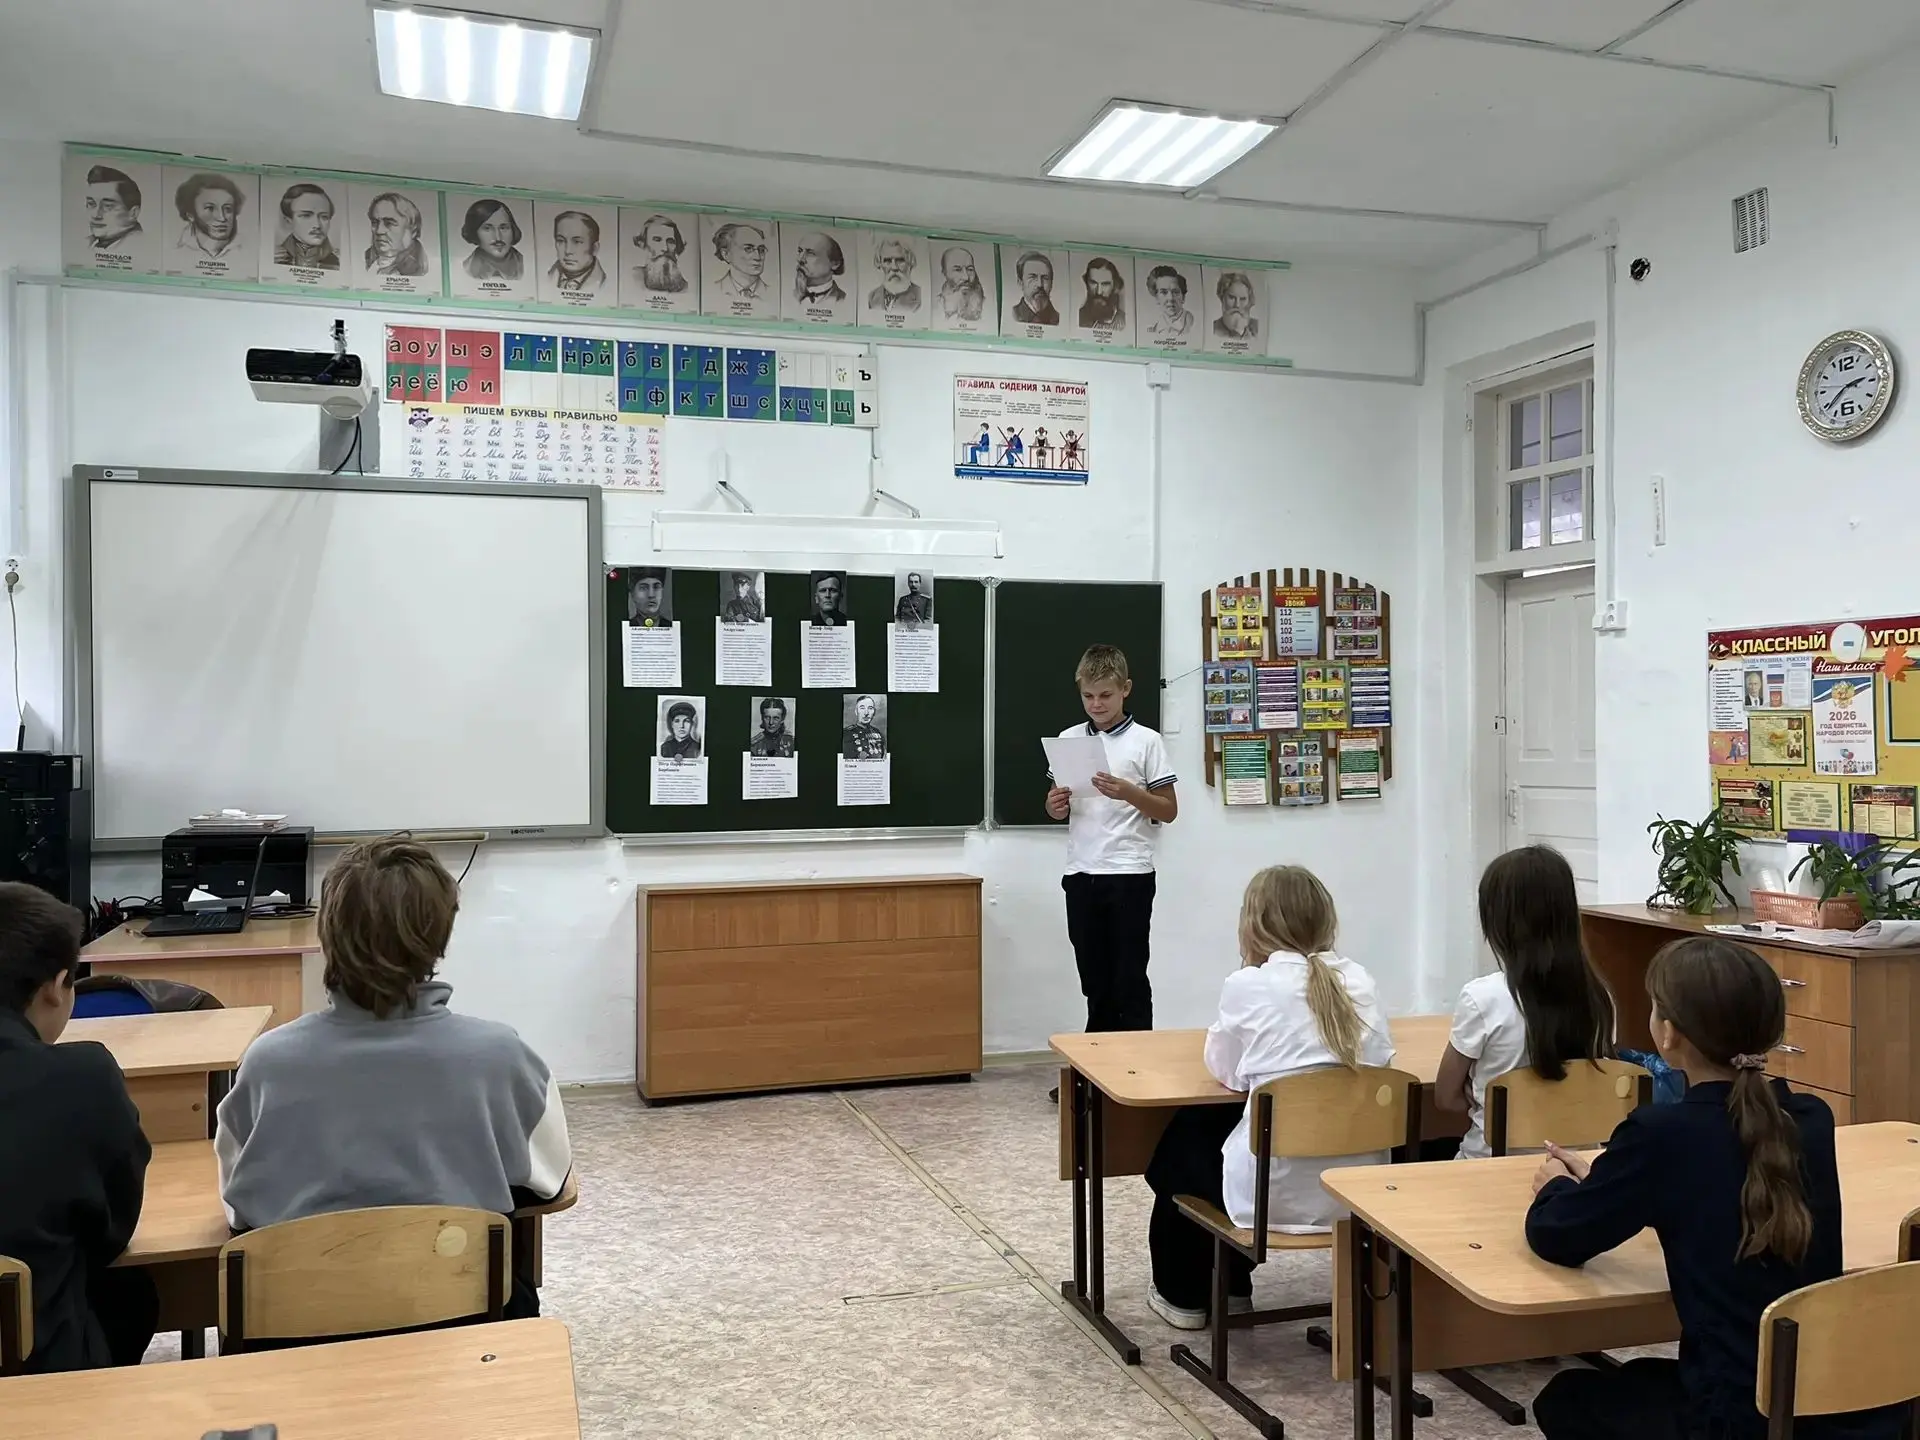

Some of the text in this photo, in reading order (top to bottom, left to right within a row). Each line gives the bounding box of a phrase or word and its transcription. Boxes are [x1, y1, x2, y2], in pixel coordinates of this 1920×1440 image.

[389, 340, 872, 381] а о у ы э л м н р й б в г д ж з ъ
[1838, 355, 1854, 372] 12
[389, 373, 872, 415] я е ё ю и п ф к т ш с х ц ч щ ь
[957, 380, 995, 389] ПРАВИЛА
[1000, 382, 1037, 391] СИДЕНИЯ
[1055, 385, 1086, 395] ПАРТОЙ
[463, 406, 618, 422] ПИШЕМ БУКВЫ ПРАВИЛЬНО
[1841, 400, 1855, 416] 6
[1280, 608, 1292, 616] 112
[1281, 636, 1293, 644] 103
[1731, 627, 1920, 655] КЛАССНЫЙ УГОЛ
[1815, 660, 1841, 673] Наш
[1843, 662, 1876, 673] класс
[1829, 711, 1857, 721] 2026
